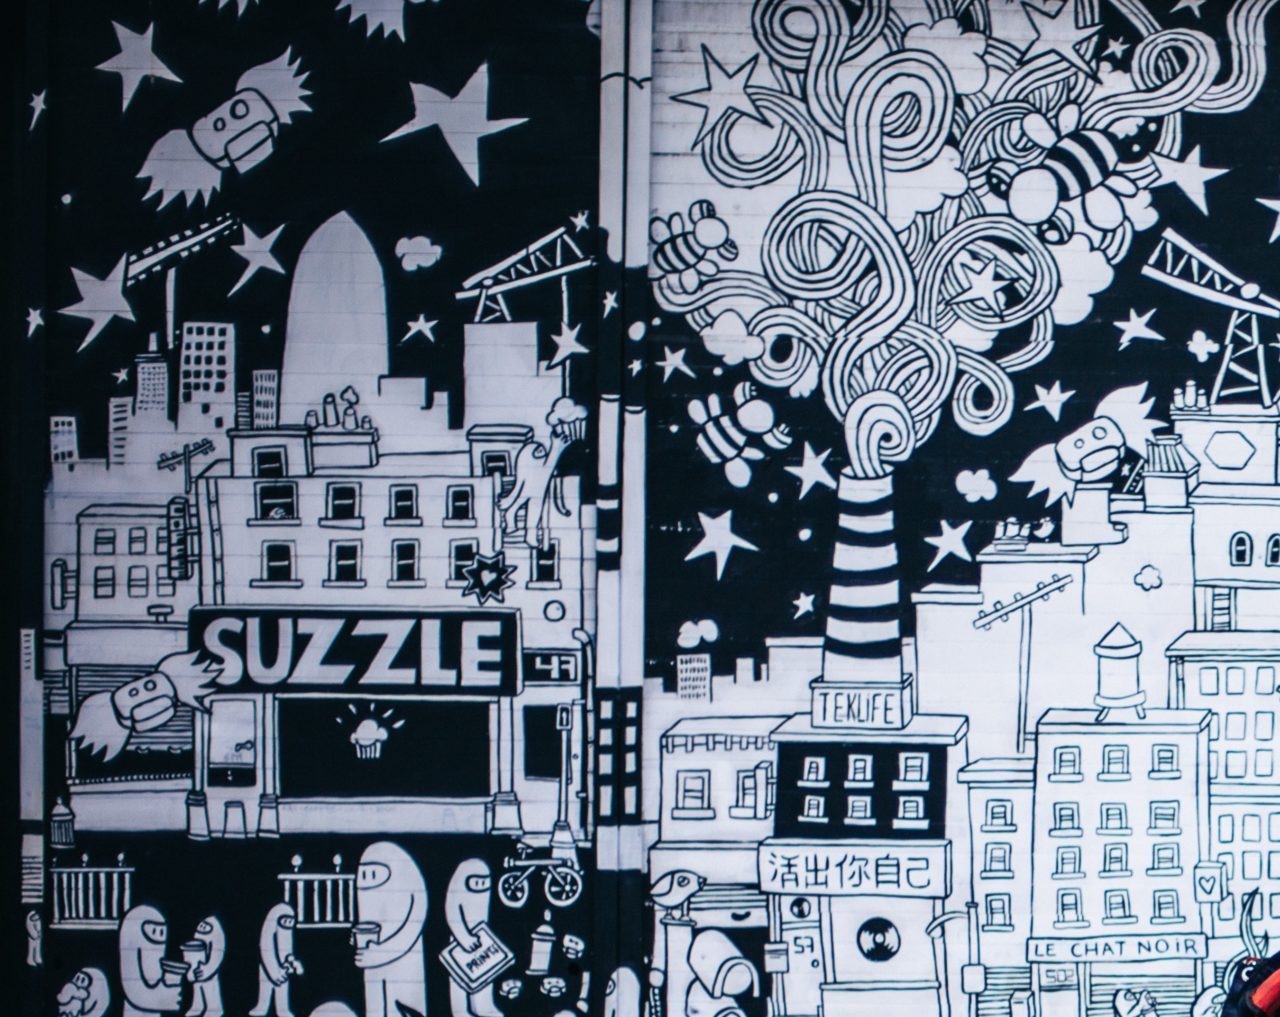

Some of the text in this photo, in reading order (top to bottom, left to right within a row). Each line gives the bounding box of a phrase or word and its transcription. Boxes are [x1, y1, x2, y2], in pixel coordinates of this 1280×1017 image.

[203, 617, 502, 686] SUZZLE
[768, 852, 931, 889] 活出你自己
[1034, 942, 1056, 957] LE
[1071, 940, 1125, 958] CHAT
